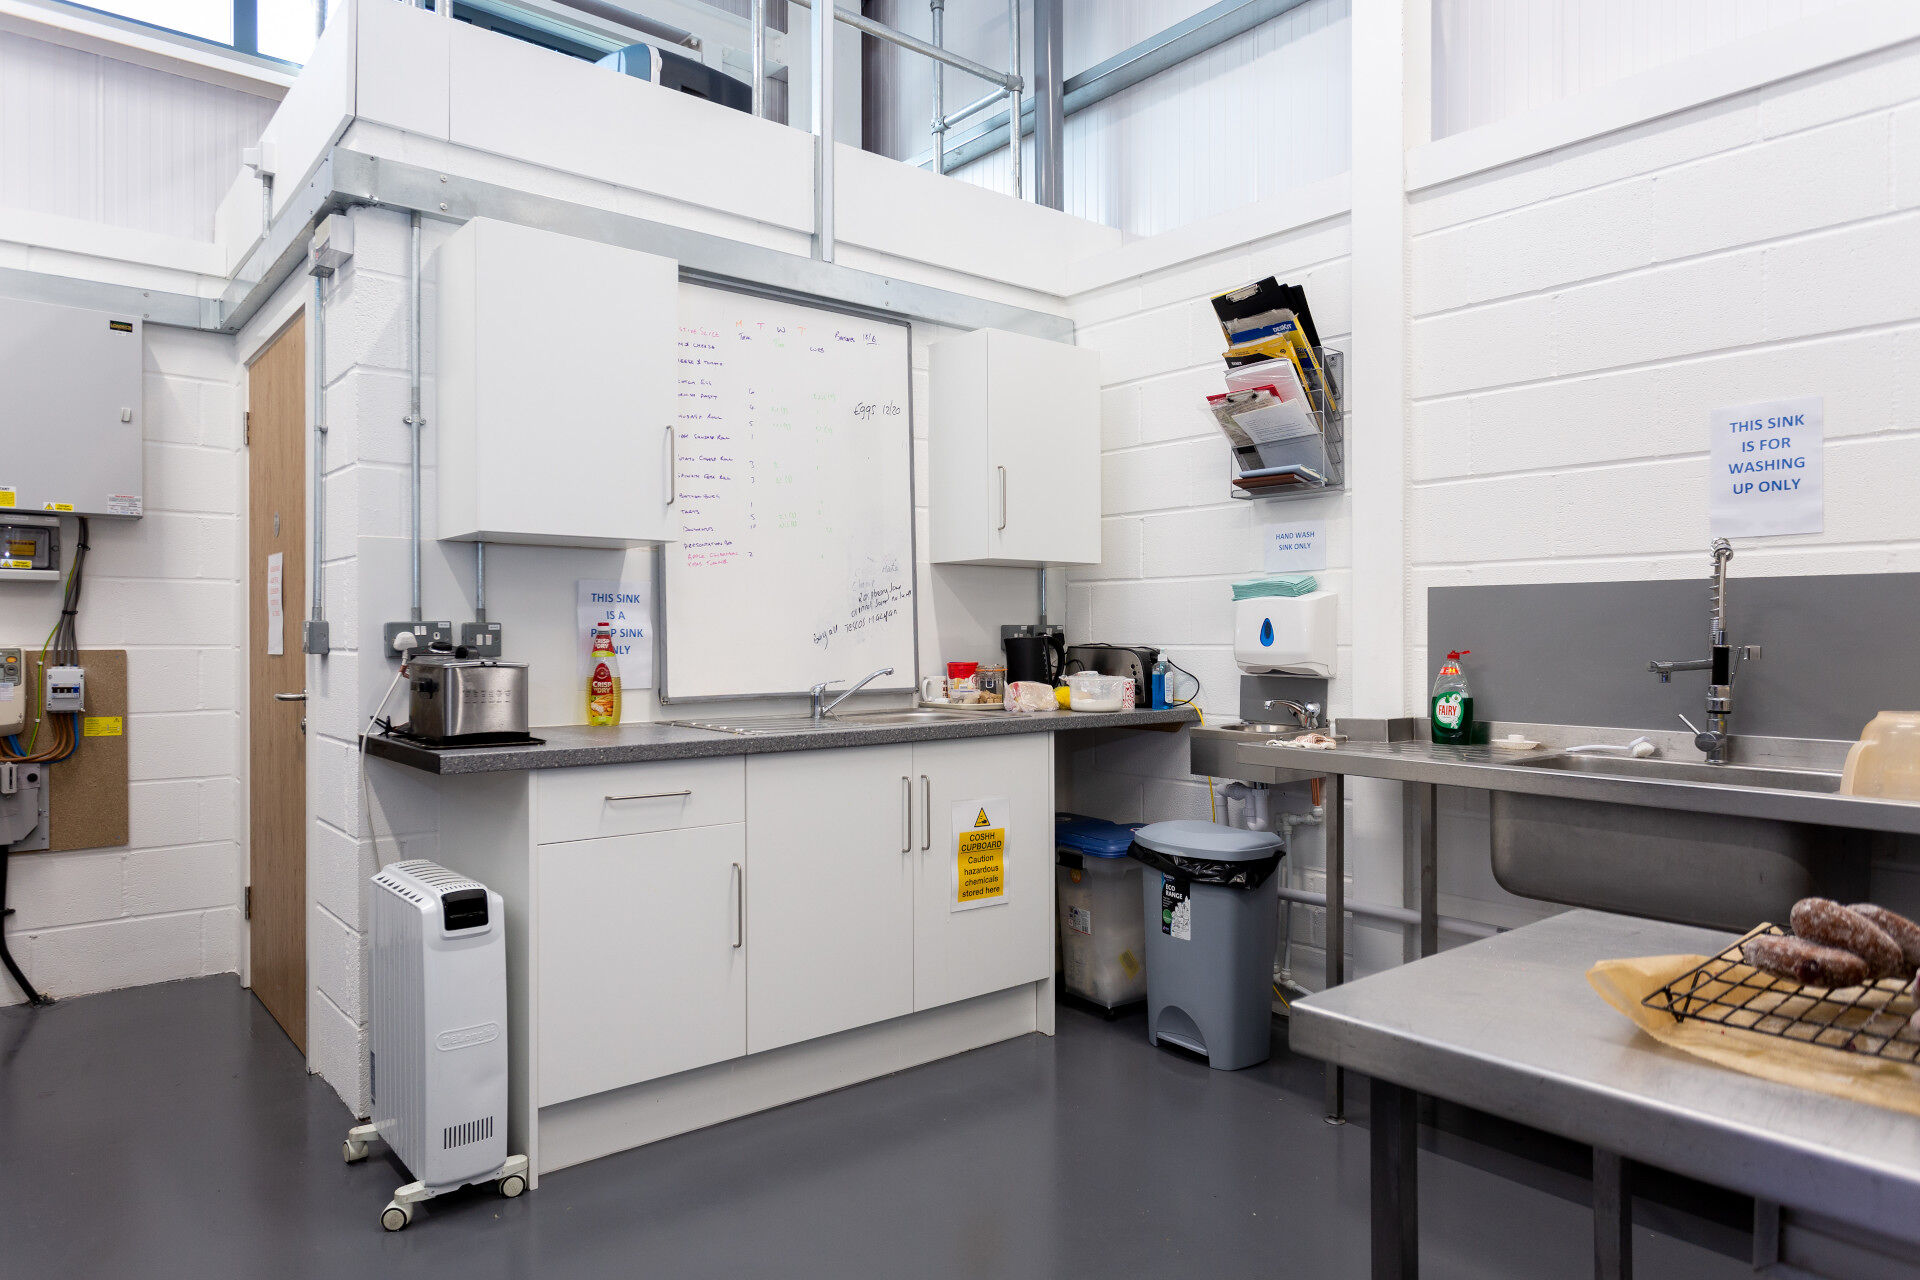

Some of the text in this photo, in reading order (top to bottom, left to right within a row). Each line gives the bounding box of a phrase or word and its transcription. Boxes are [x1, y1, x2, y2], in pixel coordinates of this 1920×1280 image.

[756, 322, 766, 331] T
[1729, 414, 1805, 433] THIS SINK
[1742, 437, 1791, 453] IS FOR
[1728, 456, 1805, 474] WASHING
[1733, 478, 1801, 494] UP ONLY
[1275, 532, 1294, 540] HAND
[1294, 542, 1311, 550] ONLY
[591, 593, 640, 603] THIS SINK
[606, 611, 625, 620] IS A
[591, 629, 643, 638] PP SINK
[613, 645, 631, 655] NLY
[1439, 705, 1457, 717] FAIRY
[969, 832, 995, 841] COSHH
[961, 841, 1002, 852] CUPBOARD
[968, 855, 994, 864] Caution
[964, 865, 999, 876] hazardous
[965, 875, 999, 886] chemicals
[962, 886, 1000, 898] stored here
[1165, 884, 1176, 892] ECO
[1165, 890, 1183, 900] RANGE
